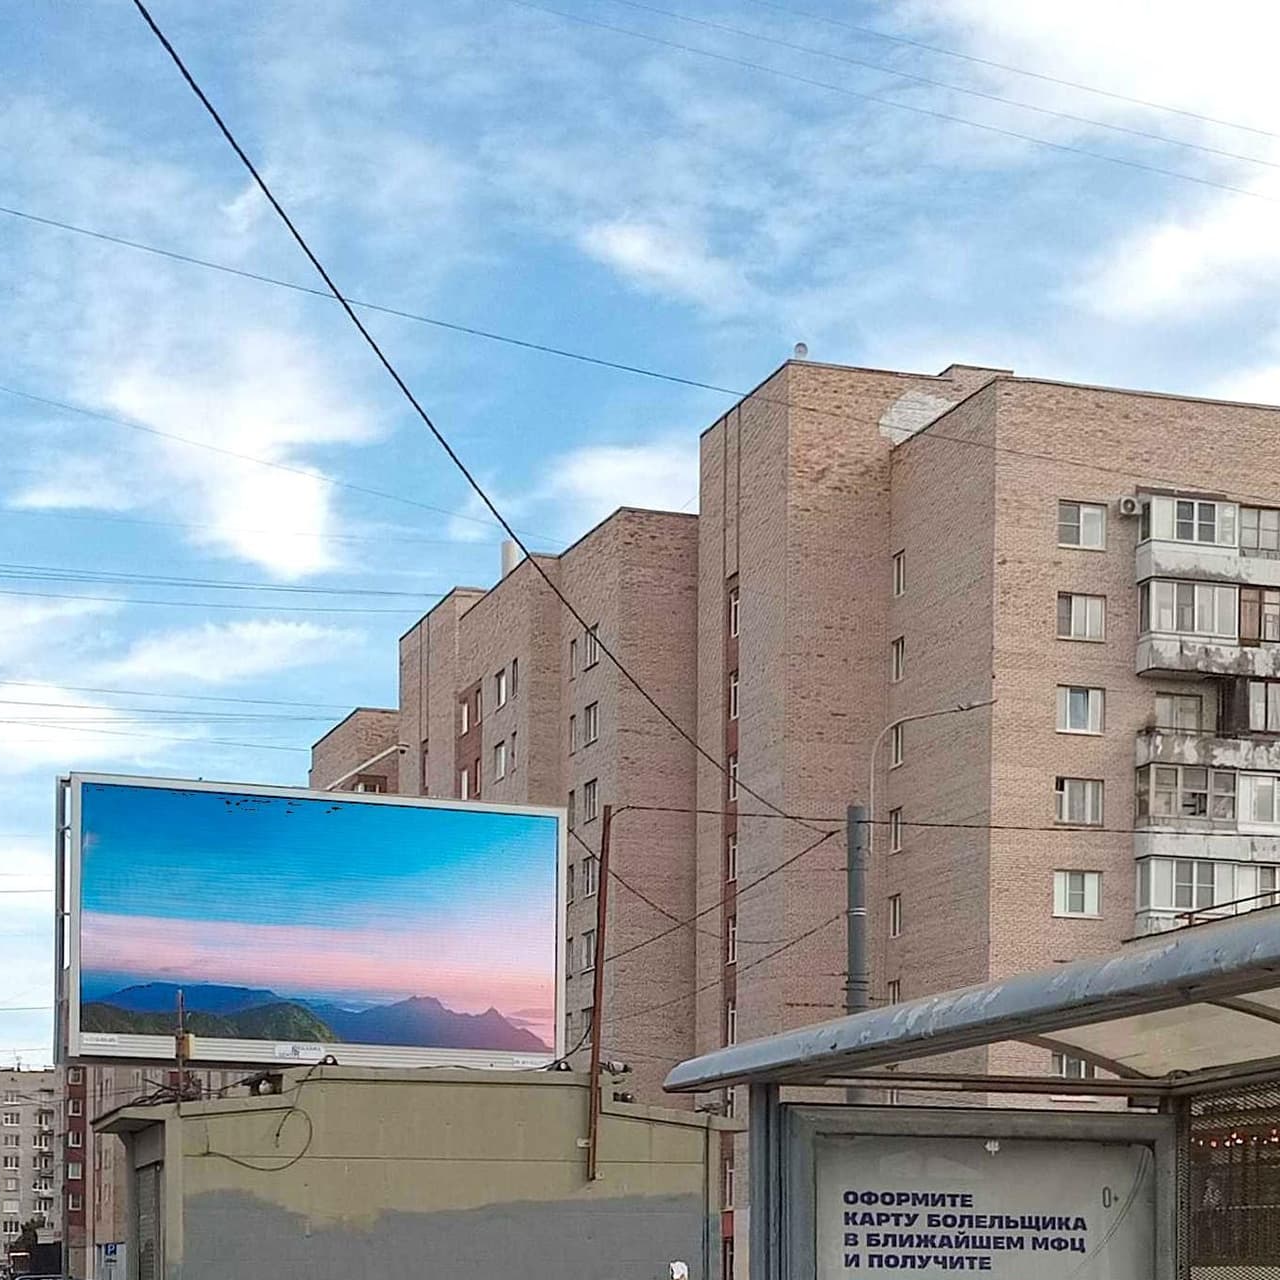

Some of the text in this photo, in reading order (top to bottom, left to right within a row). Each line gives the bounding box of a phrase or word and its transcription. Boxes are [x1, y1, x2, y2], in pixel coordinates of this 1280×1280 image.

[843, 1190, 973, 1208] ОФОРМИТЕ
[843, 1212, 1088, 1232] КАРТУ БОЛЕЛЬЩИКА
[843, 1231, 1087, 1253] В БЛИЖАЙШЕМ МФЦ
[844, 1253, 993, 1271] И ПОЛУЧИТЕ
